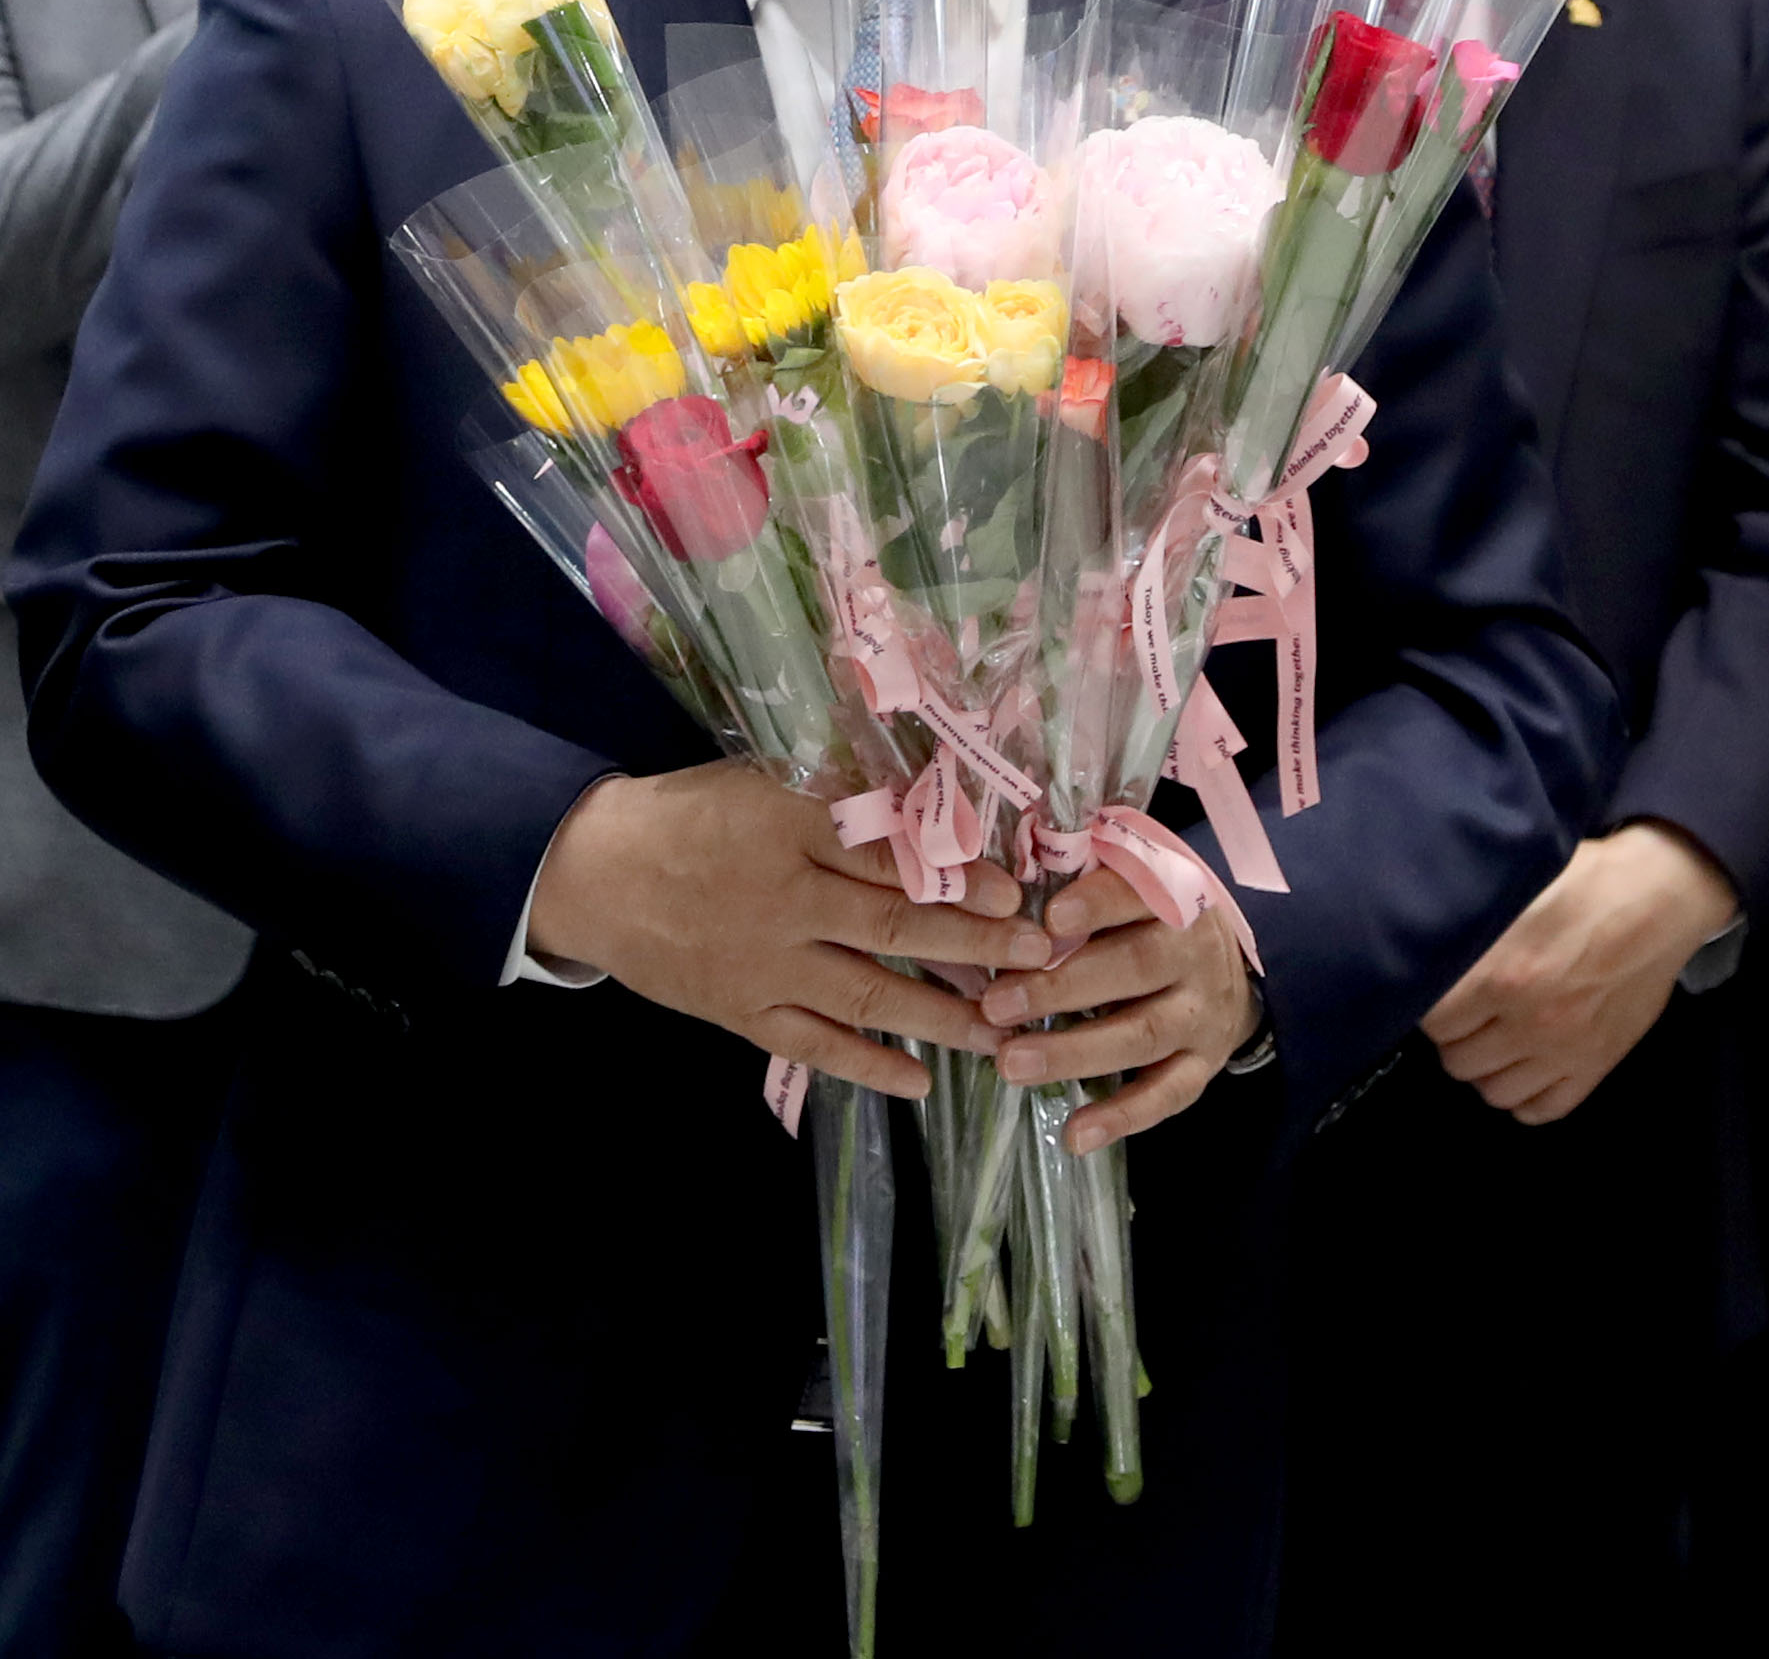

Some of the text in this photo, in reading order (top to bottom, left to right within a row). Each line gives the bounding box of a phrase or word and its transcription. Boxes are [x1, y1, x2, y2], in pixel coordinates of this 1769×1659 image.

[1287, 437, 1329, 477] thinking
[1144, 586, 1153, 625] Today
[1147, 629, 1154, 649] we
[1149, 651, 1163, 689] make
[924, 703, 969, 748] thinking
[1291, 696, 1303, 755] thinking
[969, 748, 1001, 775] make
[1293, 757, 1304, 795] make
[1001, 774, 1018, 790] we
